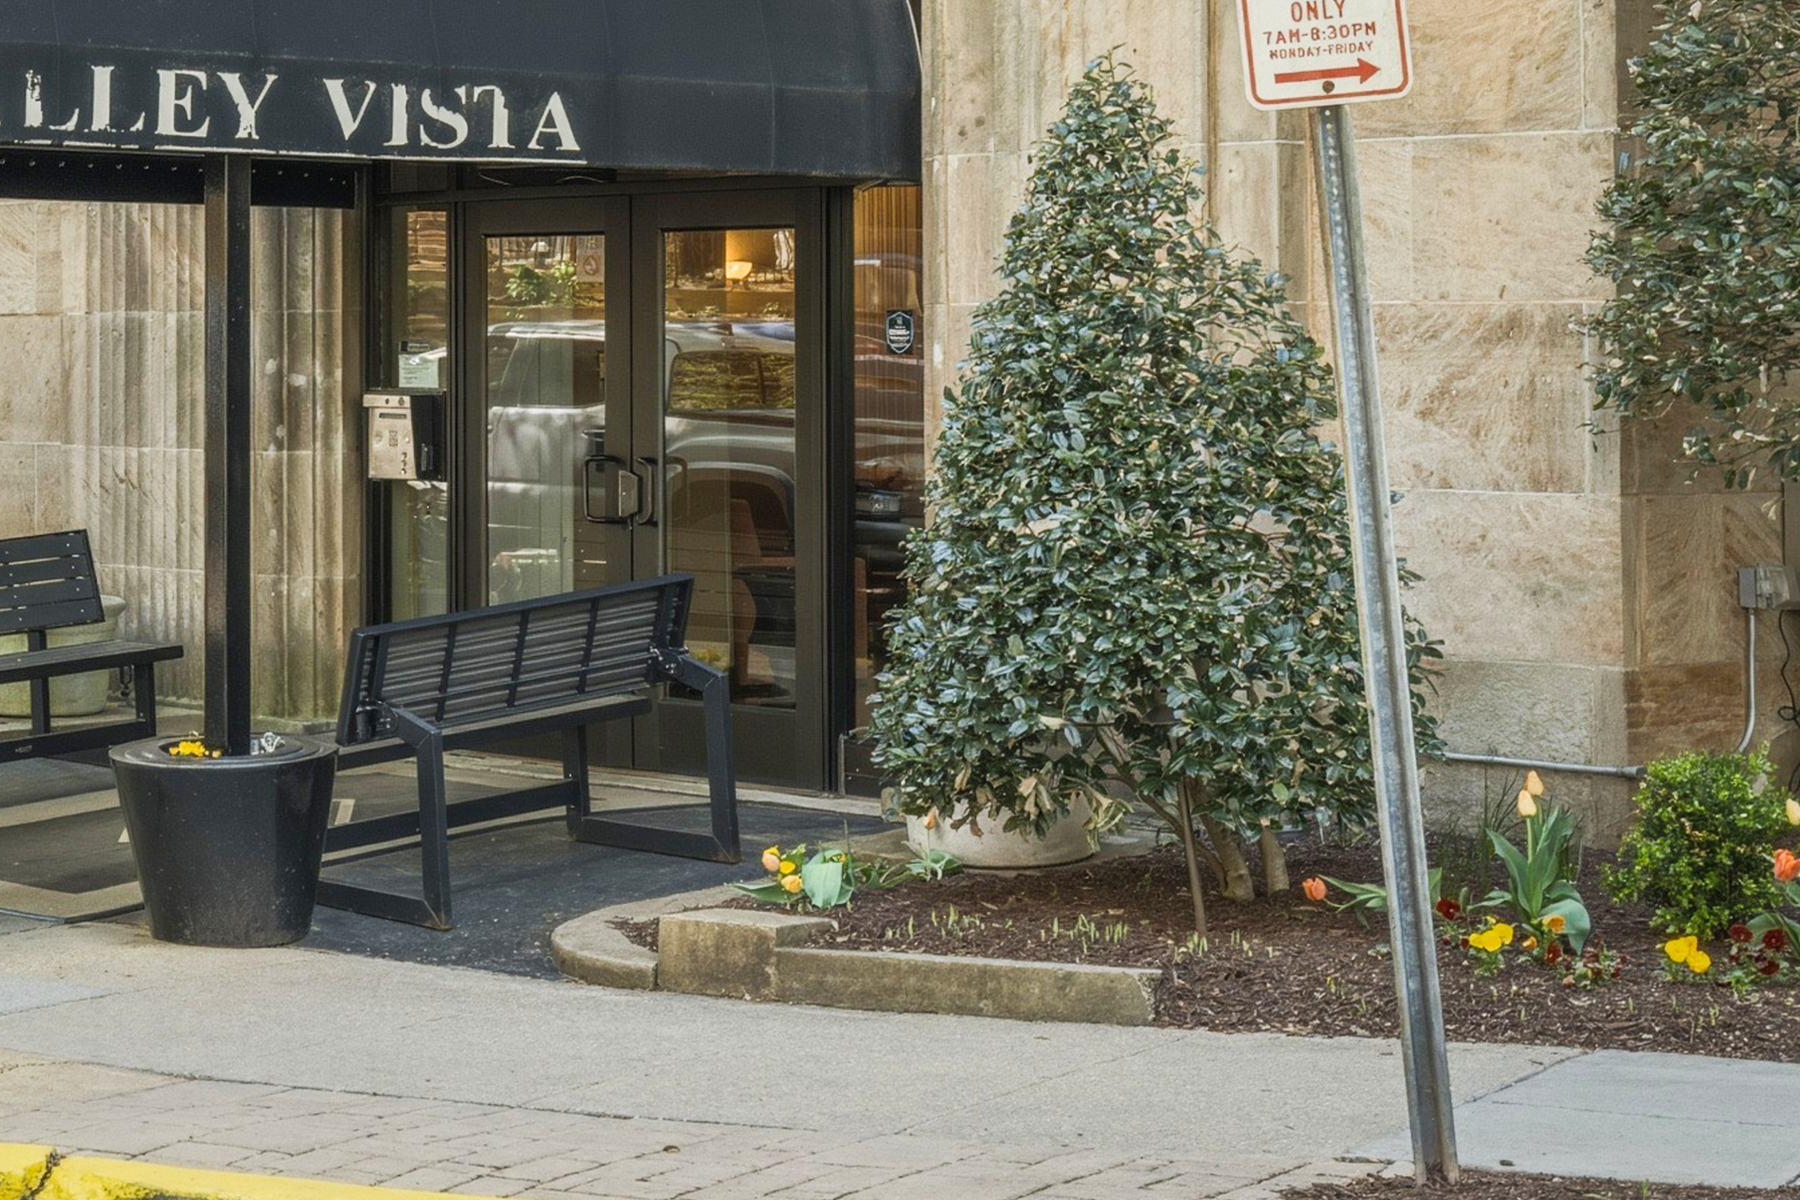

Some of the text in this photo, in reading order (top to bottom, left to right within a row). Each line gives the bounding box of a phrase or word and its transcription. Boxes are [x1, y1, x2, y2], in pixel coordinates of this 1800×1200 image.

[1263, 21, 1377, 46] 7AM-8:30PM
[1269, 40, 1375, 60] MONDAY-FRIDAY
[322, 78, 582, 152] VISTA
